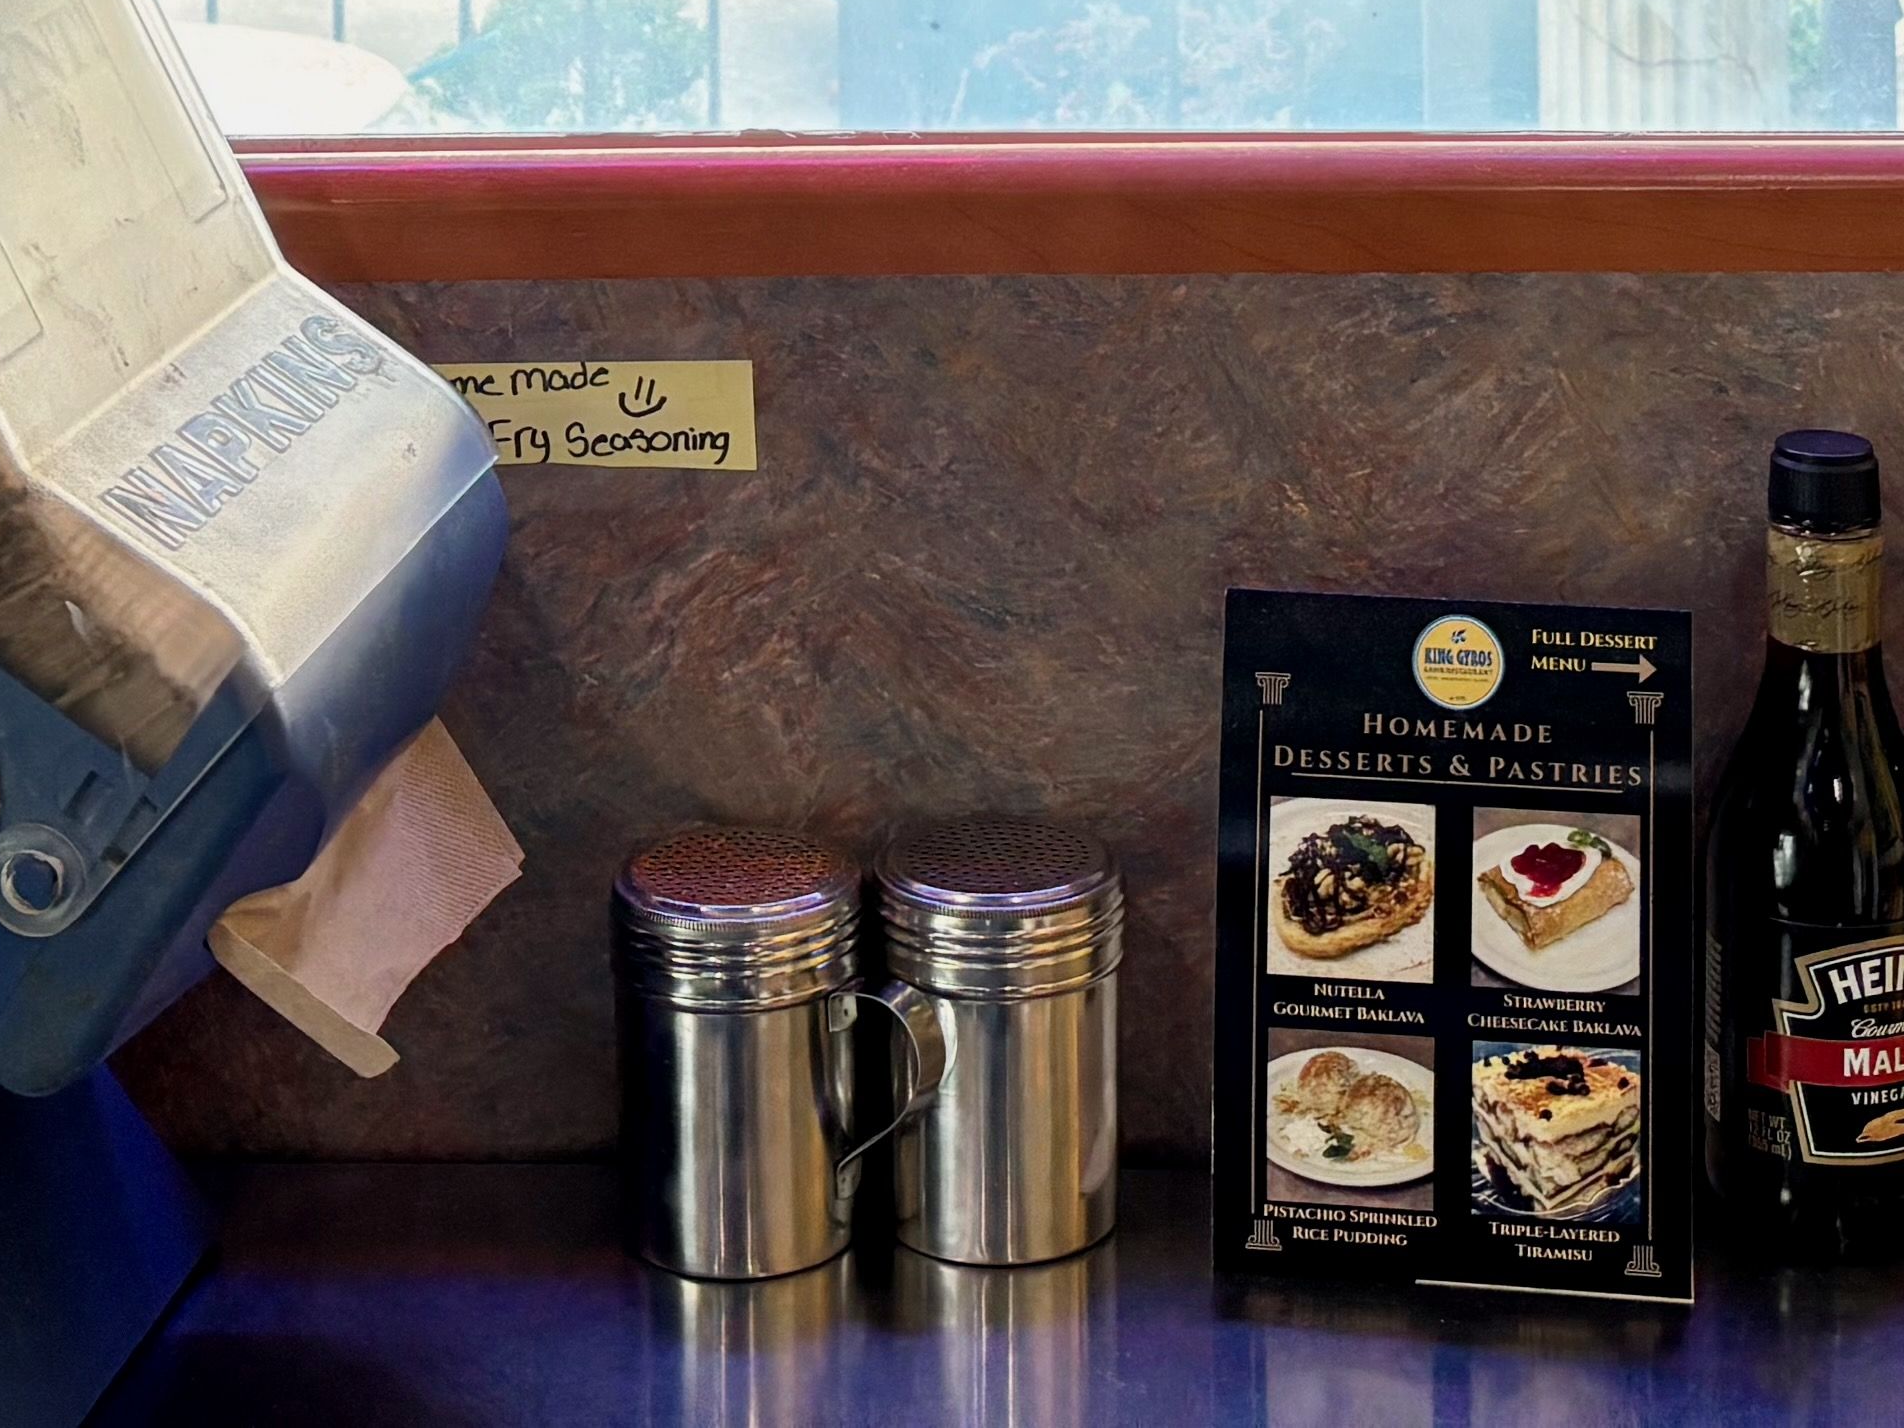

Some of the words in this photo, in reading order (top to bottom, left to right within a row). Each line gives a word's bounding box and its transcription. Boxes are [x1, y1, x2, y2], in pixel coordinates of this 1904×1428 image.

[451, 373, 505, 396] me
[100, 314, 380, 553] NAPKINS
[565, 421, 730, 465] Seasoning
[1531, 629, 1576, 647] FULL
[1580, 630, 1658, 651] DESSERT
[1423, 647, 1454, 665] KING
[1456, 649, 1493, 668] GYROS
[1531, 655, 1586, 673] MENU
[1363, 712, 1553, 744] HOMEMADE
[1274, 745, 1433, 775] DESSERTS
[1449, 754, 1472, 778] &
[1489, 756, 1642, 787] PASTRIES
[1313, 982, 1386, 1001] NUTELLA
[1273, 1000, 1353, 1019] GOURMET
[1357, 1006, 1426, 1025] BAKLAVA
[1503, 994, 1607, 1014] STRAWBERRY
[1467, 1013, 1569, 1033] CHEESECAKE
[1572, 1019, 1643, 1038] BAKLAVA
[1263, 1203, 1347, 1223] PISTACHIO
[1349, 1209, 1438, 1229] SPRINKLED
[1292, 1226, 1329, 1242] RICE
[1333, 1228, 1408, 1247] PUDDING
[1489, 1221, 1621, 1244] TRIPLE-LAYERED
[1515, 1243, 1594, 1263] TIRAMISU
